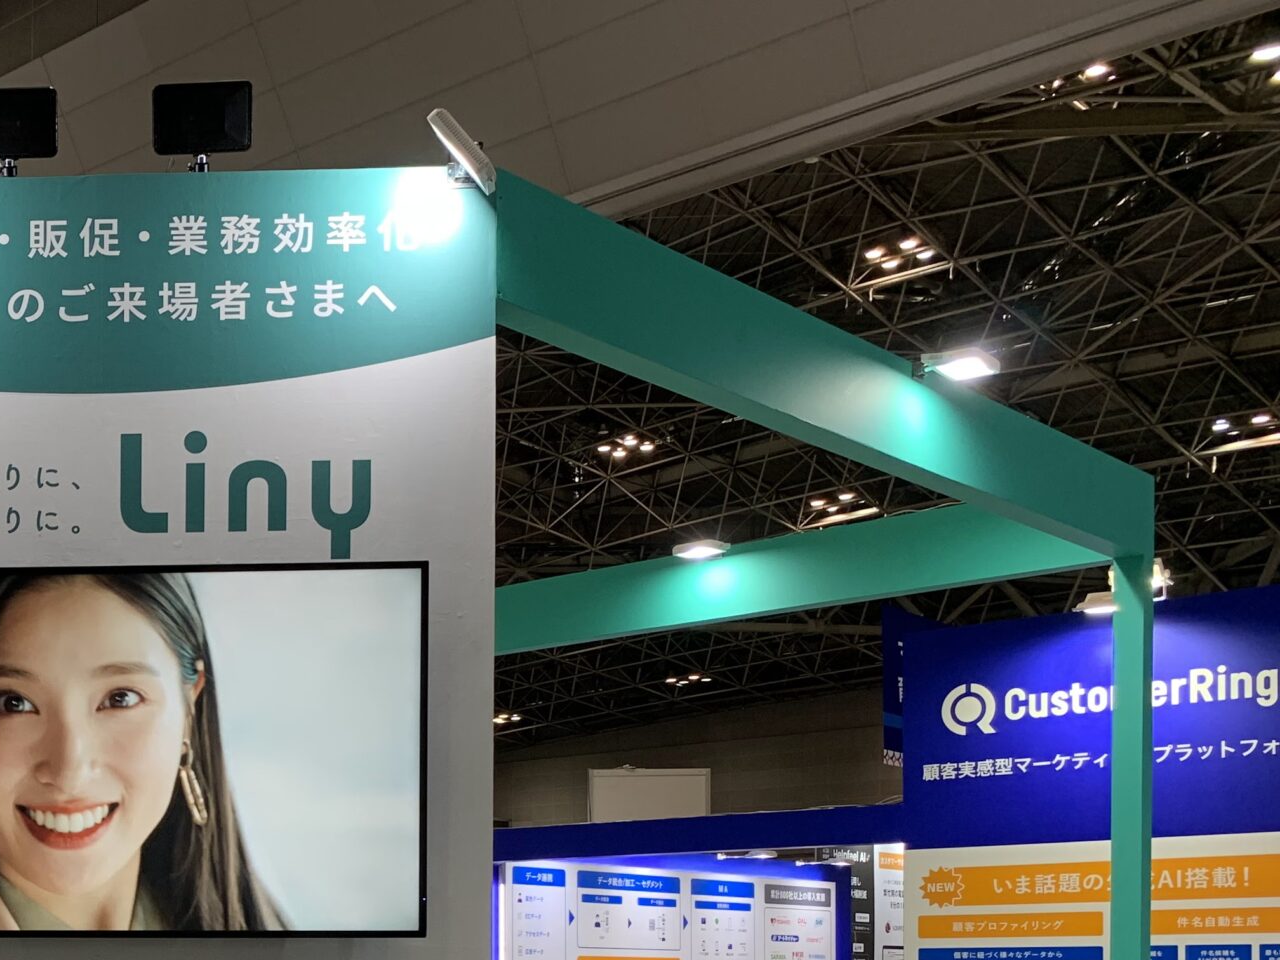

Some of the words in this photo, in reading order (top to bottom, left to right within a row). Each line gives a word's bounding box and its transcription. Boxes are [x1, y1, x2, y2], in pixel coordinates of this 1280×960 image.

[120, 430, 372, 559] Liny
[1004, 665, 1279, 720] CustoerRing
[927, 882, 956, 894] NEW
[952, 919, 1064, 932] 顧客プロファイリング
[1177, 915, 1260, 928] 件名自動生成
